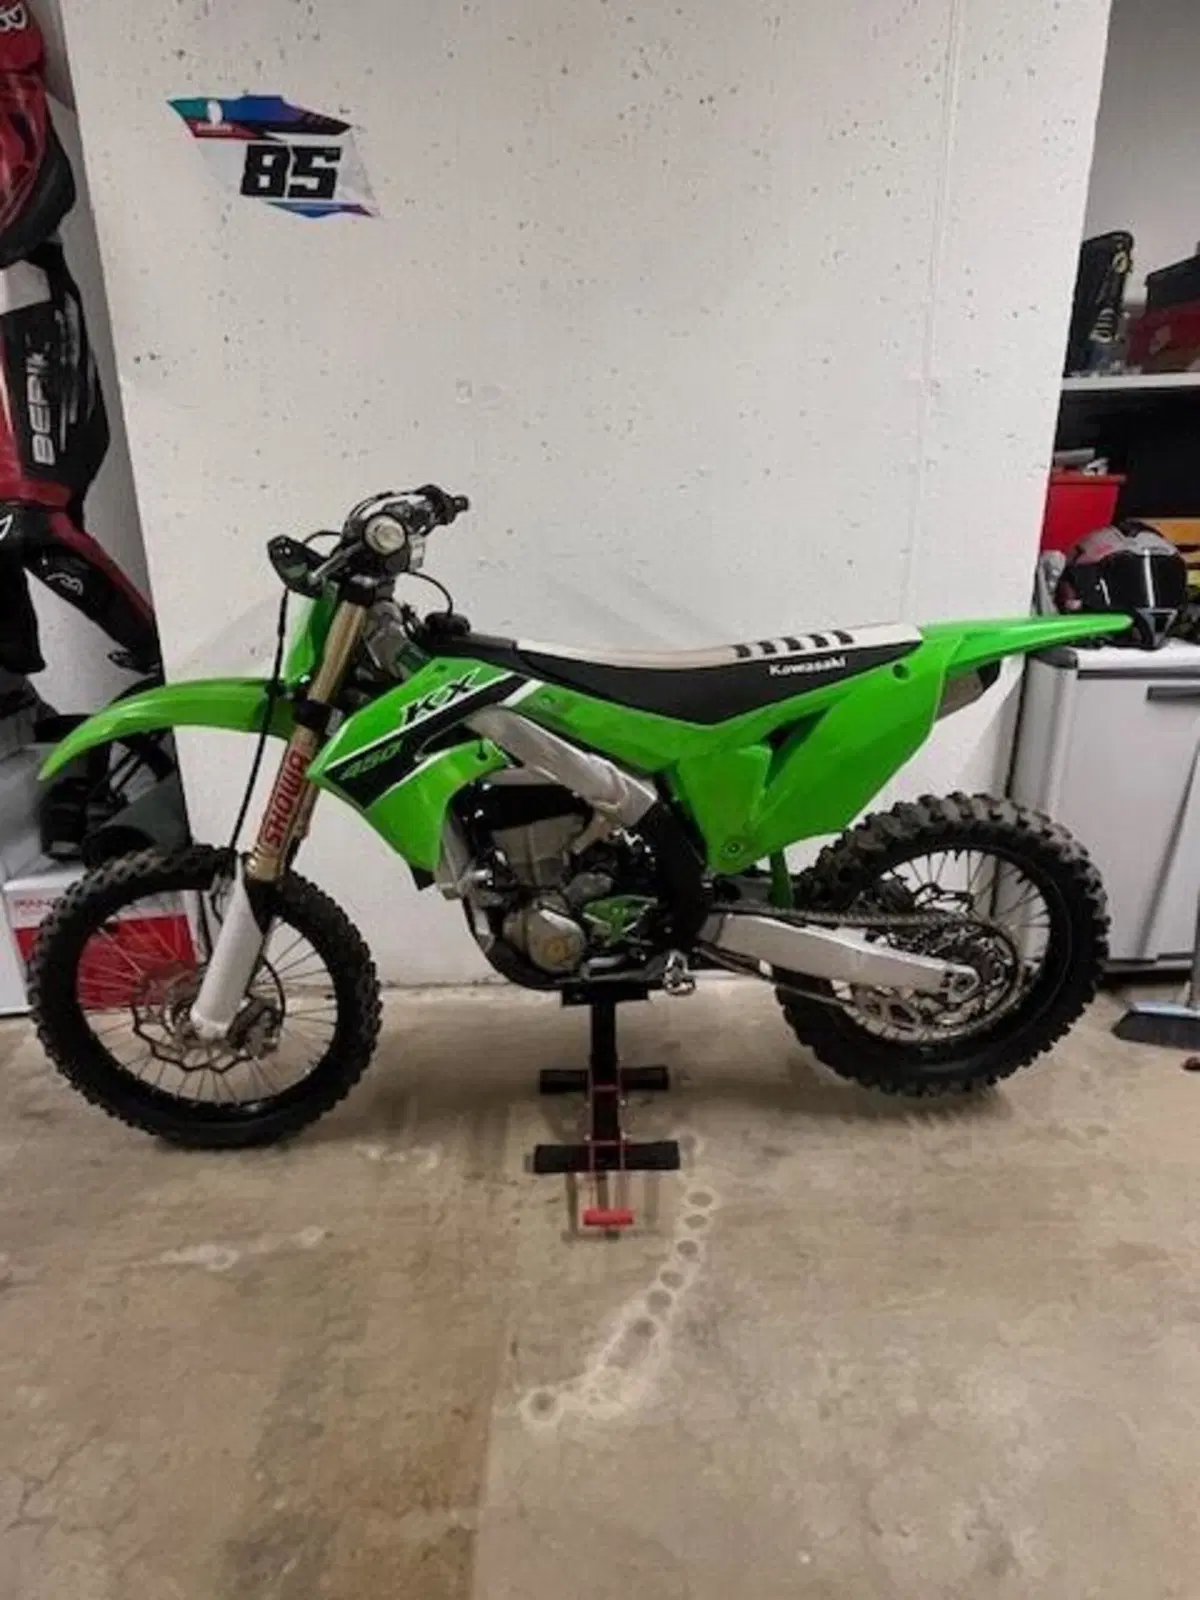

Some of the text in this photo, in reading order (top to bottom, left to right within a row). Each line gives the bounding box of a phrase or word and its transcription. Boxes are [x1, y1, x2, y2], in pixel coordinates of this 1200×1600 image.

[241, 144, 342, 199] 85
[769, 656, 846, 676] Kawasaki
[404, 670, 475, 724] KX
[264, 748, 310, 849] SHOWA
